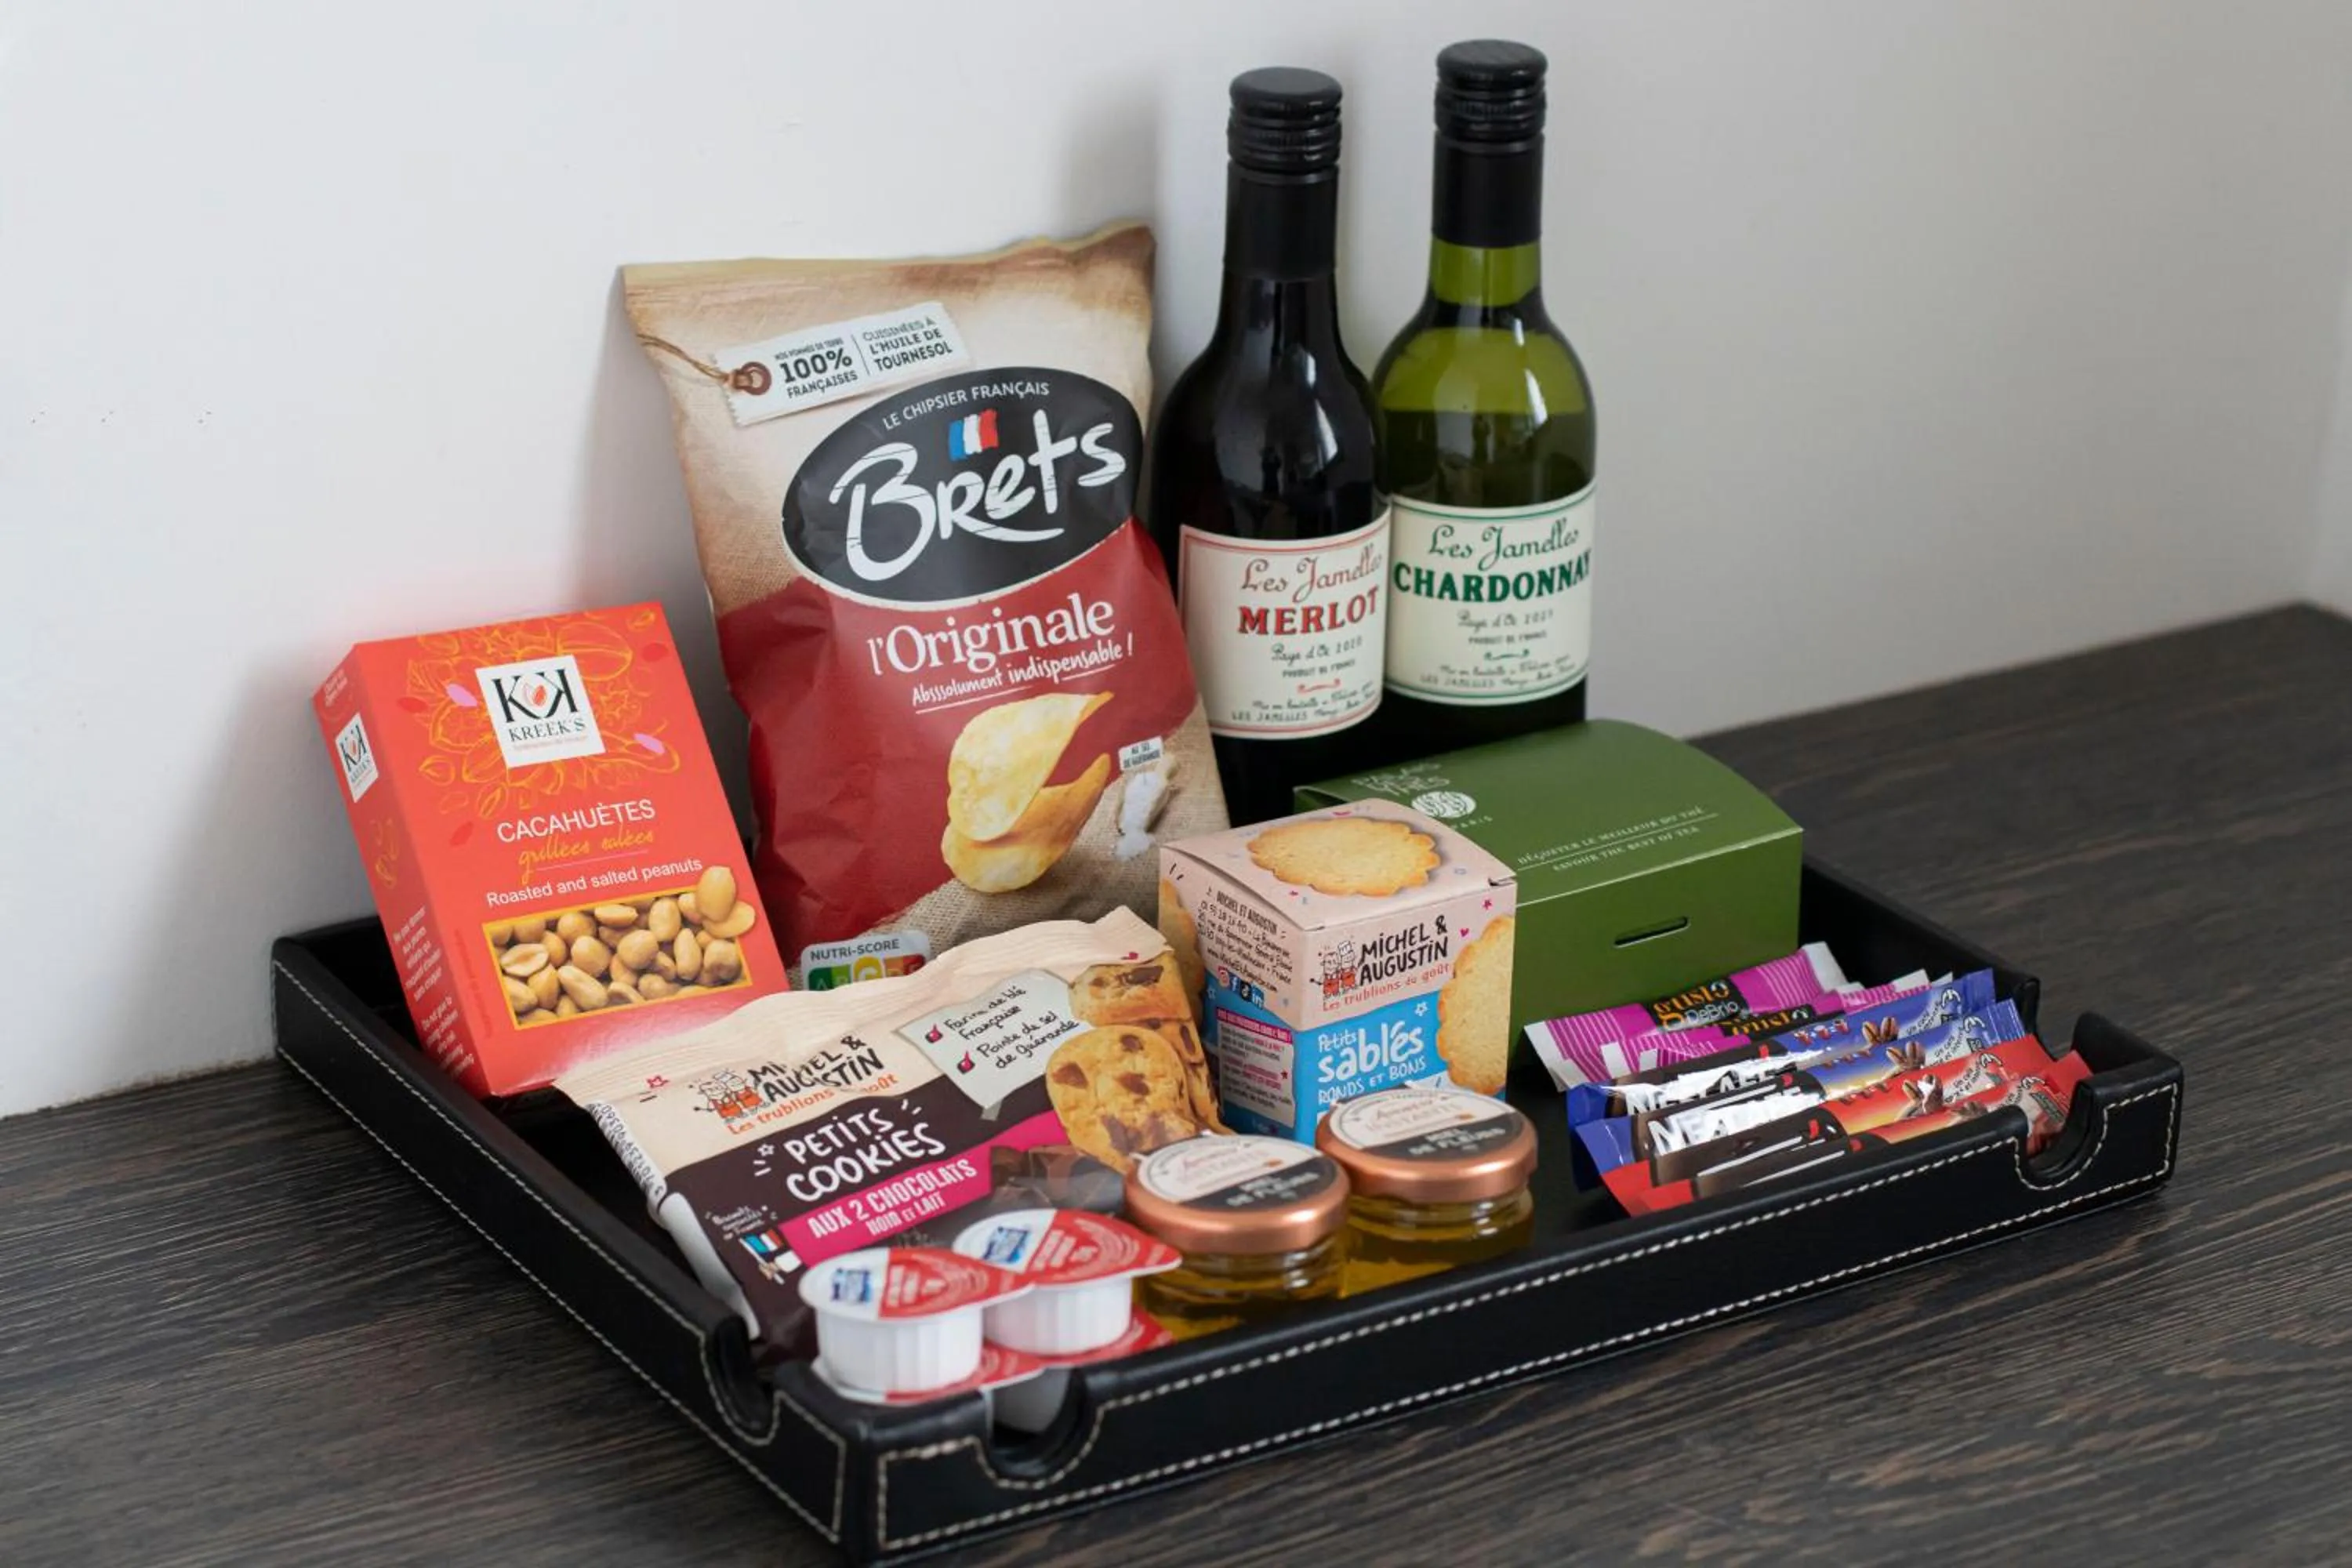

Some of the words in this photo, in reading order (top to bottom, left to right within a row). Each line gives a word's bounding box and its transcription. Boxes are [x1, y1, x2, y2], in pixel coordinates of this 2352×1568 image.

[863, 321, 924, 341] CUISINÉES
[869, 333, 922, 354] L'HUILE
[924, 328, 942, 341] DE
[780, 347, 852, 383] 100%
[874, 340, 953, 371] TOURNESOL
[786, 370, 858, 398] FRANÇAISES
[882, 415, 901, 431] LE
[903, 390, 968, 422] CHIPSIER
[971, 381, 1050, 401] FRANÇAIS
[829, 408, 1127, 582] Brets
[1428, 524, 1474, 559] Les
[1241, 557, 1290, 593] Les
[1236, 585, 1379, 636] MERLOT
[867, 592, 1116, 676] l'Originale
[1007, 640, 1123, 684] indispensable
[508, 717, 586, 742] KREEK'S
[496, 799, 655, 843] CACAHUÈTES
[486, 883, 552, 907] Roasted
[557, 877, 587, 894] and
[591, 867, 638, 888] salted
[641, 858, 703, 881] peanuts
[810, 938, 900, 960] NUTRI-SCORE
[1359, 923, 1430, 963] MICHEL
[1436, 914, 1448, 935] &
[1359, 936, 1448, 986] AUGUSTIN
[841, 1035, 866, 1051] &
[977, 1033, 1021, 1058] Pointe
[1022, 1022, 1040, 1035] de
[996, 1054, 1016, 1069] de
[1317, 1020, 1425, 1083] sablés
[1318, 1029, 1357, 1053] Petits
[1318, 1076, 1365, 1105] RONDS
[1370, 1073, 1385, 1087] ET
[1388, 1055, 1427, 1080] BONS
[757, 1088, 836, 1124] trublions
[783, 1108, 895, 1165] PETITS
[786, 1123, 946, 1202] COOKIES
[808, 1207, 852, 1239] AUX
[849, 1199, 870, 1221] 2
[866, 1159, 978, 1213] CHOCOLATS
[866, 1209, 902, 1236] NOIR
[901, 1207, 916, 1223] ET
[913, 1192, 946, 1216] LAIT
